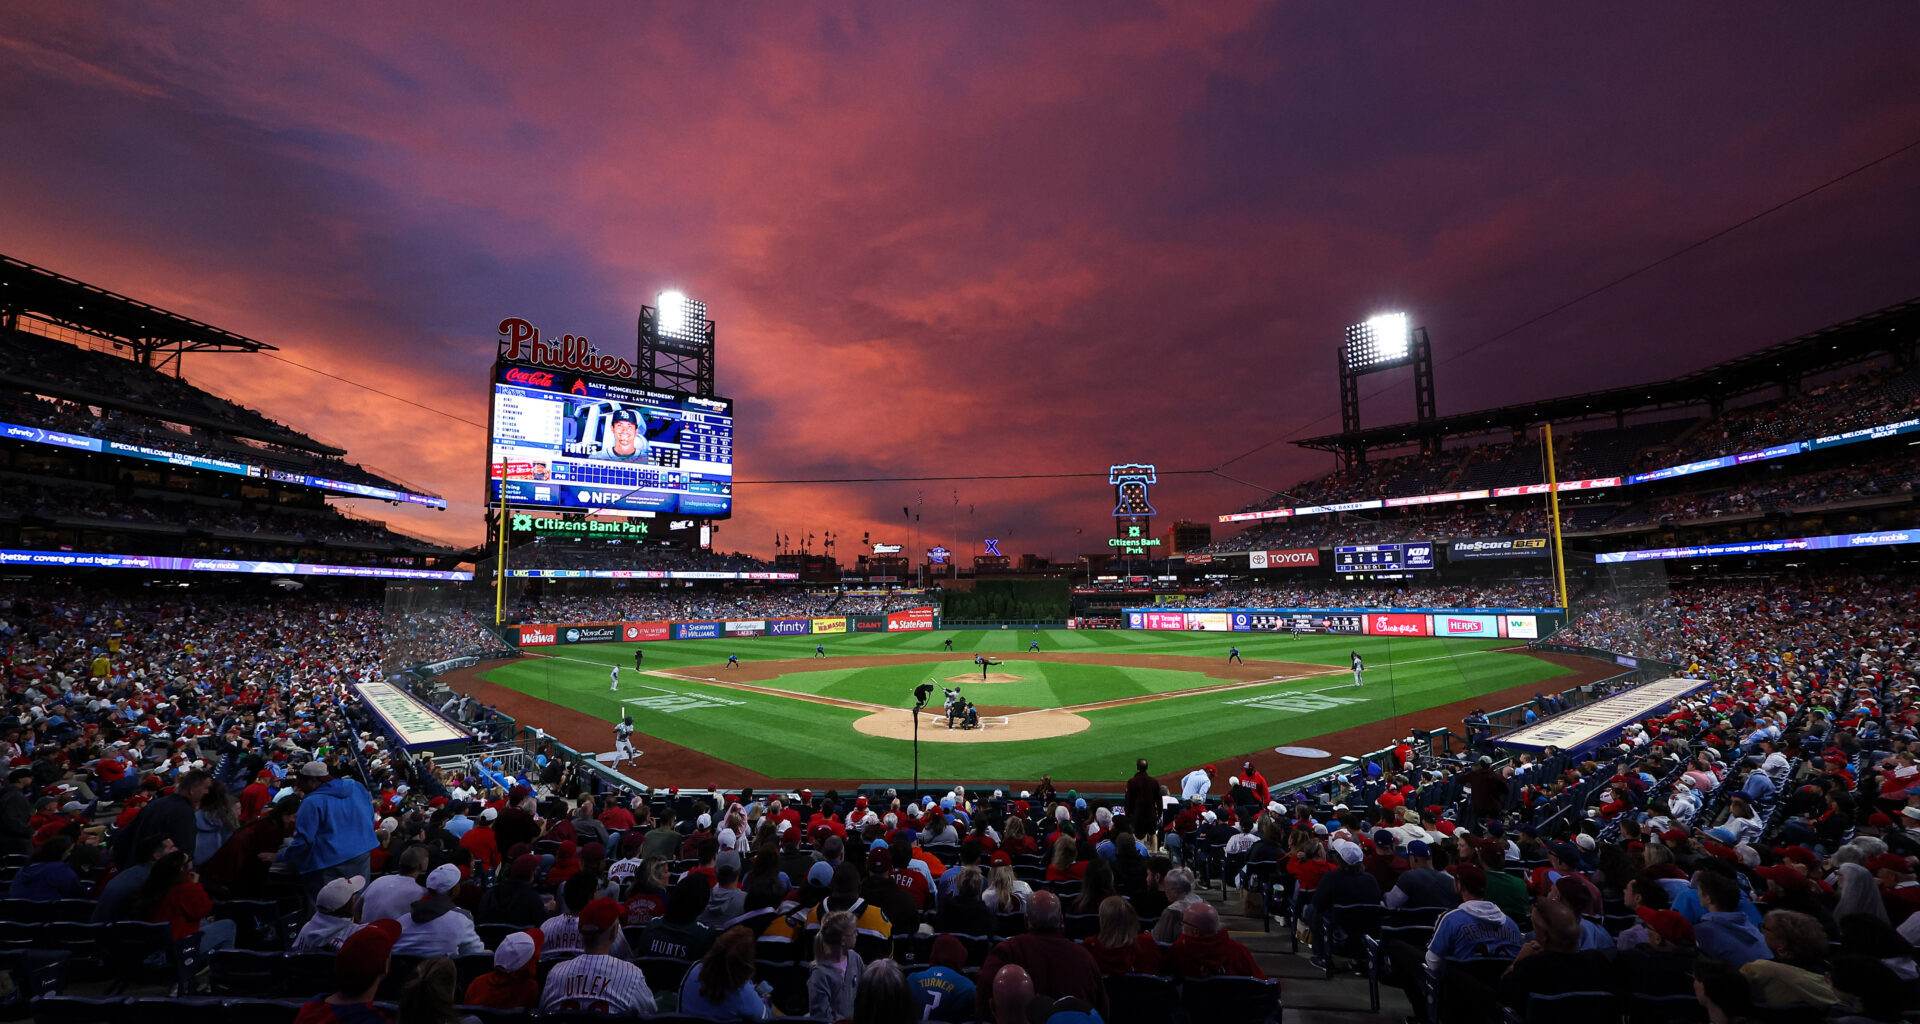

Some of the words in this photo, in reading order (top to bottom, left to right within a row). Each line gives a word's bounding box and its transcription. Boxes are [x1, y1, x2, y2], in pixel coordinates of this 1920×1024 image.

[499, 318, 632, 378] Phillies
[506, 368, 554, 387] Coca-Cola
[588, 382, 606, 390] SALTZ
[608, 386, 645, 396] MONGELUZZI
[647, 391, 675, 400] BENDESKY
[605, 392, 629, 400] INJURY
[632, 397, 659, 405] LAWYERS
[7, 427, 35, 438] xfinity
[49, 434, 66, 443] Pitch
[67, 437, 90, 447] Speed
[1816, 435, 1842, 444] SPECIAL
[1841, 428, 1875, 439] WELCOME
[1885, 418, 1920, 431] CREATIVE
[565, 443, 598, 455] FORTES
[110, 442, 139, 453] SPECIAL
[140, 447, 173, 458] WELCOME
[183, 454, 212, 464] CREATIVE
[212, 459, 242, 470] FINANCIAL
[592, 491, 620, 504] NFP
[1338, 503, 1363, 511] BAKERY
[535, 518, 587, 531] Citizens
[589, 519, 621, 532] Bank
[622, 522, 648, 534] Park
[1108, 538, 1140, 547] Citizens
[1141, 538, 1161, 546] Bank
[1851, 535, 1877, 545] xfinity
[1879, 532, 1909, 542] mobile
[1454, 541, 1512, 551] theScore
[1764, 542, 1783, 551] bigger
[1784, 540, 1808, 549] savings
[1, 552, 32, 562] better
[33, 554, 75, 564] coverage
[77, 555, 94, 564] and
[95, 556, 120, 566] bigger
[122, 557, 149, 567] savings
[1270, 553, 1315, 563] TOYOTA
[217, 561, 239, 570] mobile
[513, 569, 529, 577] UKG
[540, 569, 555, 577] UKG
[580, 628, 615, 637] NovaCare
[773, 621, 806, 634] xfinity
[1450, 621, 1479, 631] HERR'S
[521, 633, 555, 644] Wawa
[891, 873, 914, 888] PER
[548, 932, 582, 949] HARPE
[650, 939, 687, 958] HURTS
[566, 974, 611, 997] UTLEY
[919, 978, 955, 992] TURNER
[922, 990, 942, 1021] 7
